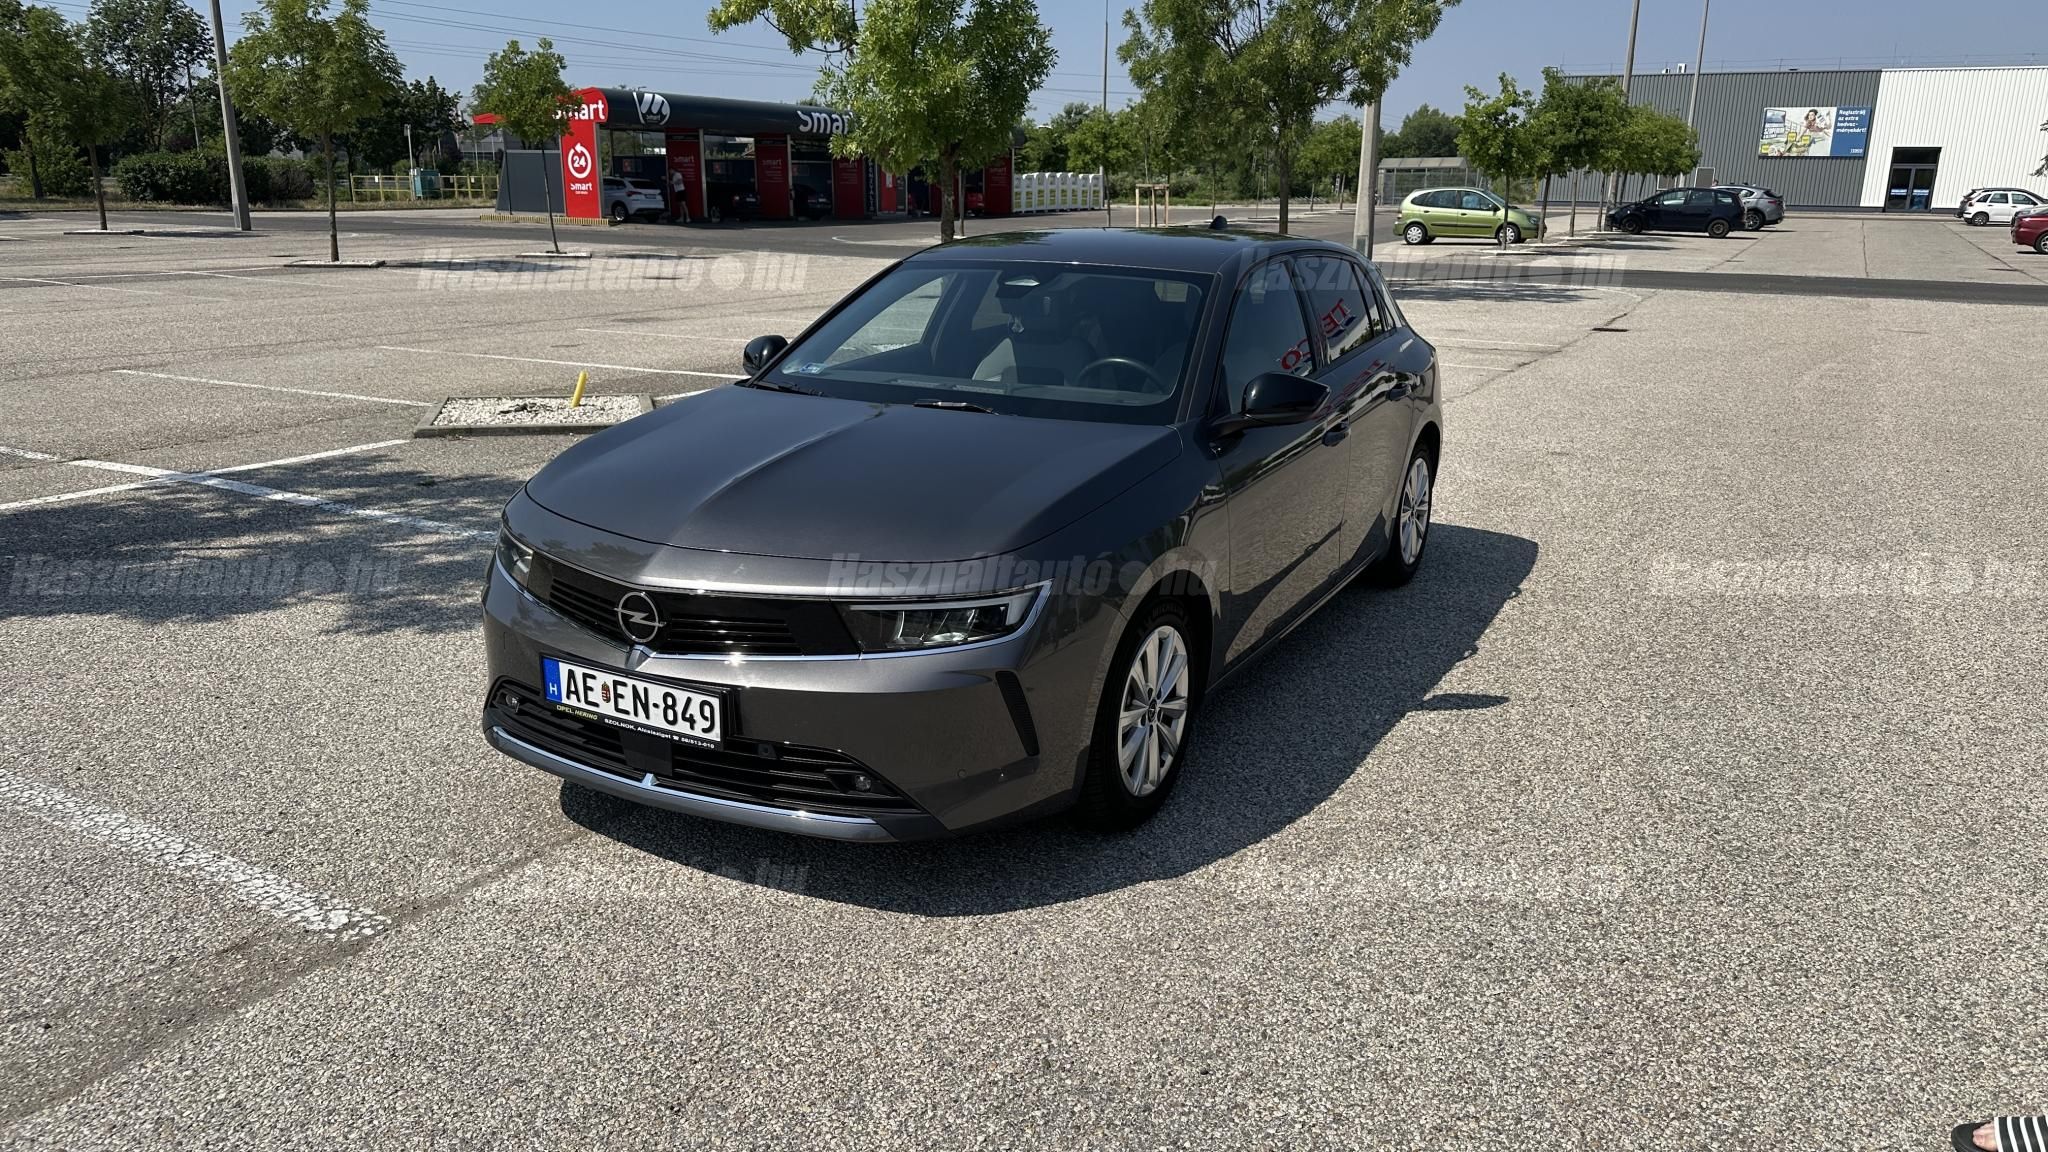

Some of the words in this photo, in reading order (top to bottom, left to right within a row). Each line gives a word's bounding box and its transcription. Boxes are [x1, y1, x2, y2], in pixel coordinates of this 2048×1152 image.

[797, 110, 852, 135] Smar
[573, 156, 586, 168] 24
[570, 182, 593, 191] Smart
[549, 682, 558, 696] H
[566, 668, 599, 708] AE
[612, 679, 715, 734] EN-849
